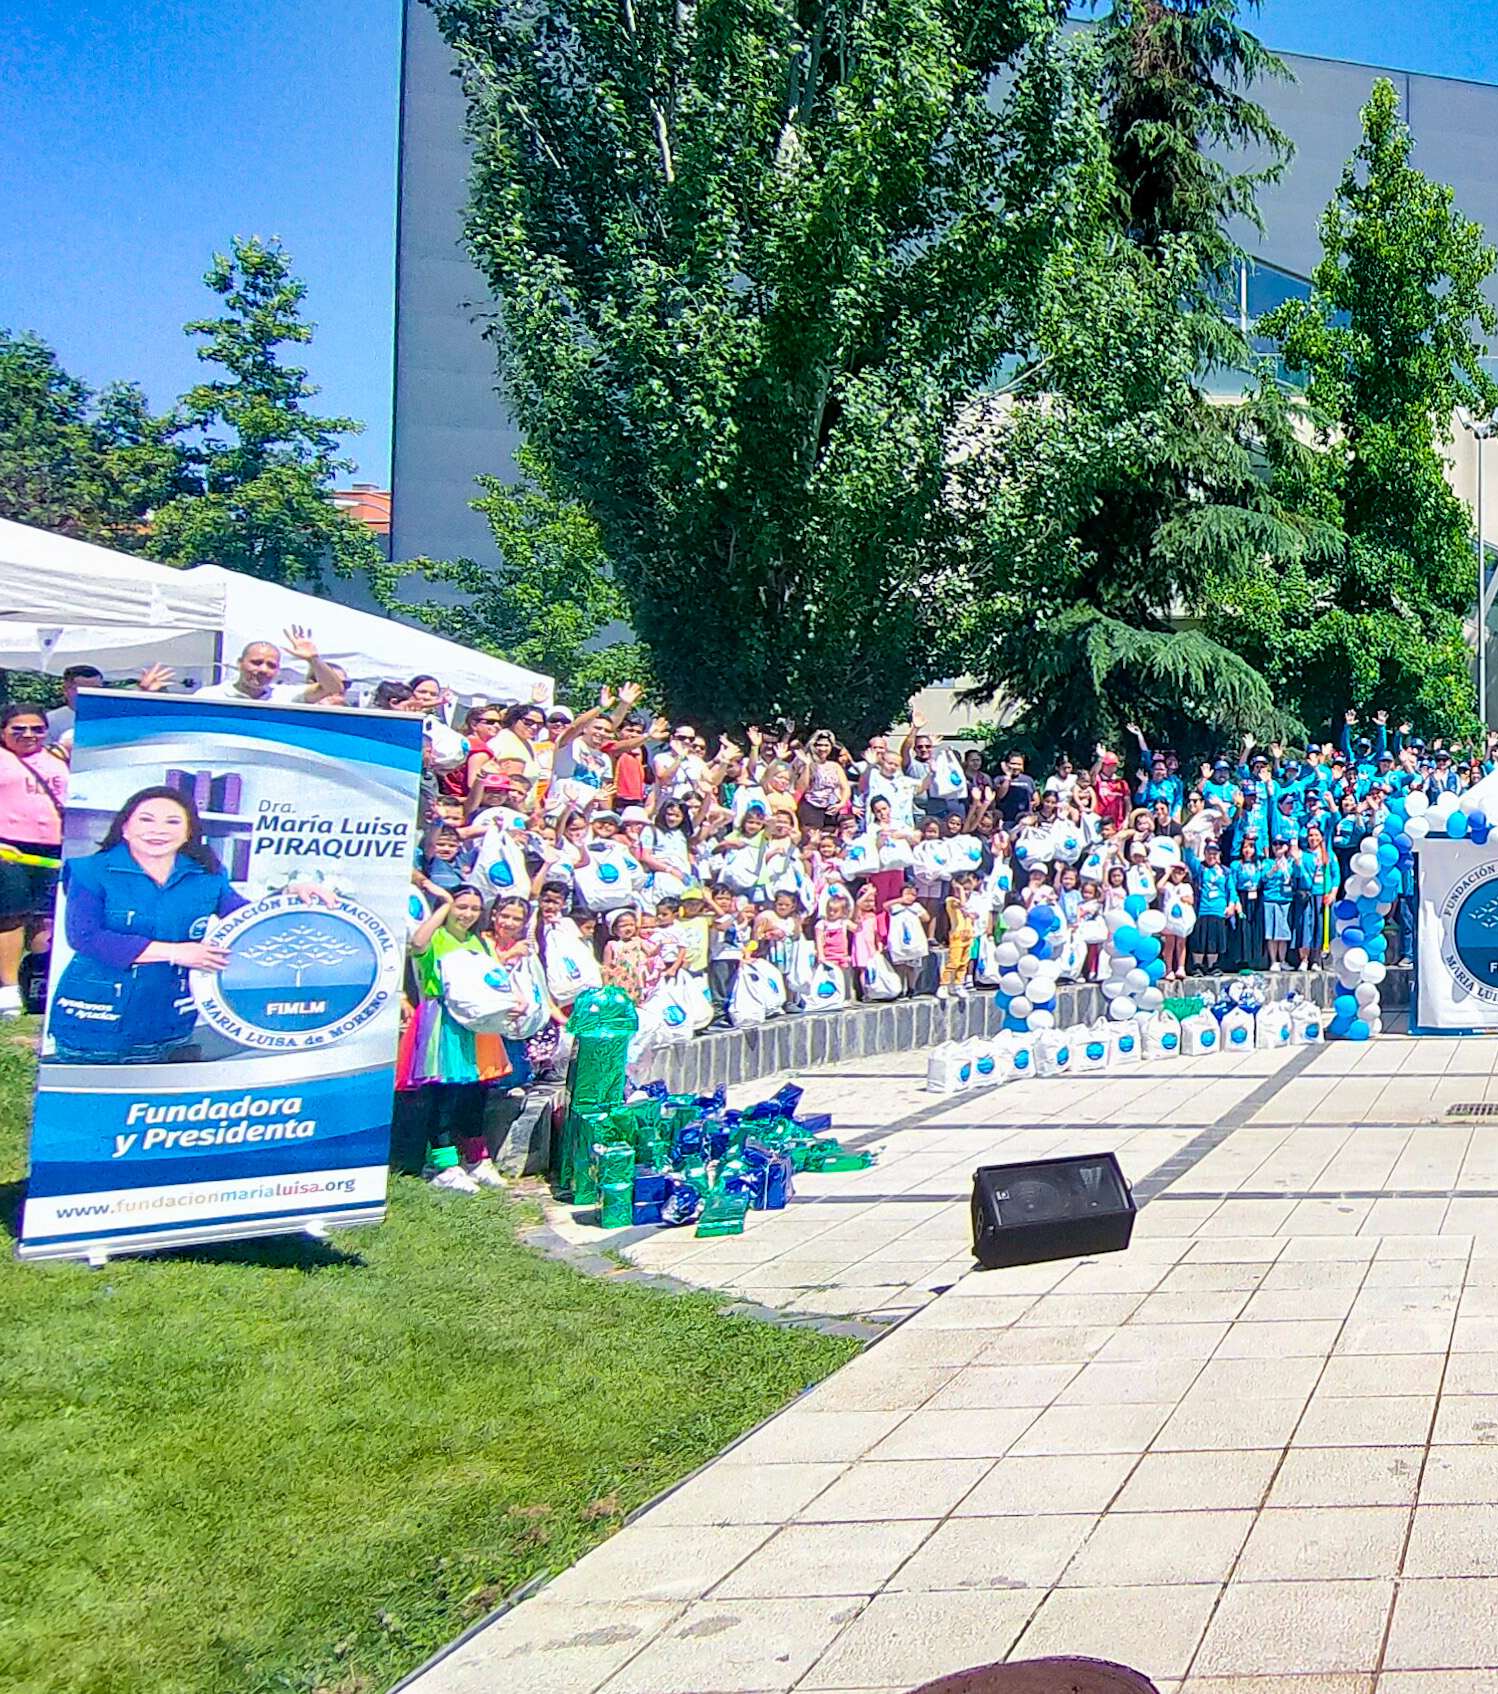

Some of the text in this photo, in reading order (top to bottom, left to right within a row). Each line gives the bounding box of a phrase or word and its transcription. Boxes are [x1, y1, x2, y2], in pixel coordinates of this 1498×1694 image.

[258, 799, 297, 814] Dra.
[255, 814, 408, 836] María Luisa
[254, 836, 408, 859] PIRAQUIVE
[1443, 865, 1497, 918] FUNDACIÓN
[209, 897, 281, 948] UNDACIÓN
[245, 1031, 298, 1047] LUISA
[304, 1035, 325, 1046] de
[328, 990, 388, 1039] MORENO
[266, 1000, 327, 1016] FIMLM
[126, 1096, 303, 1126] Fundadora
[111, 1119, 317, 1159] y Presidenta
[56, 1177, 356, 1219] www.fundacionmarialuisa.org
